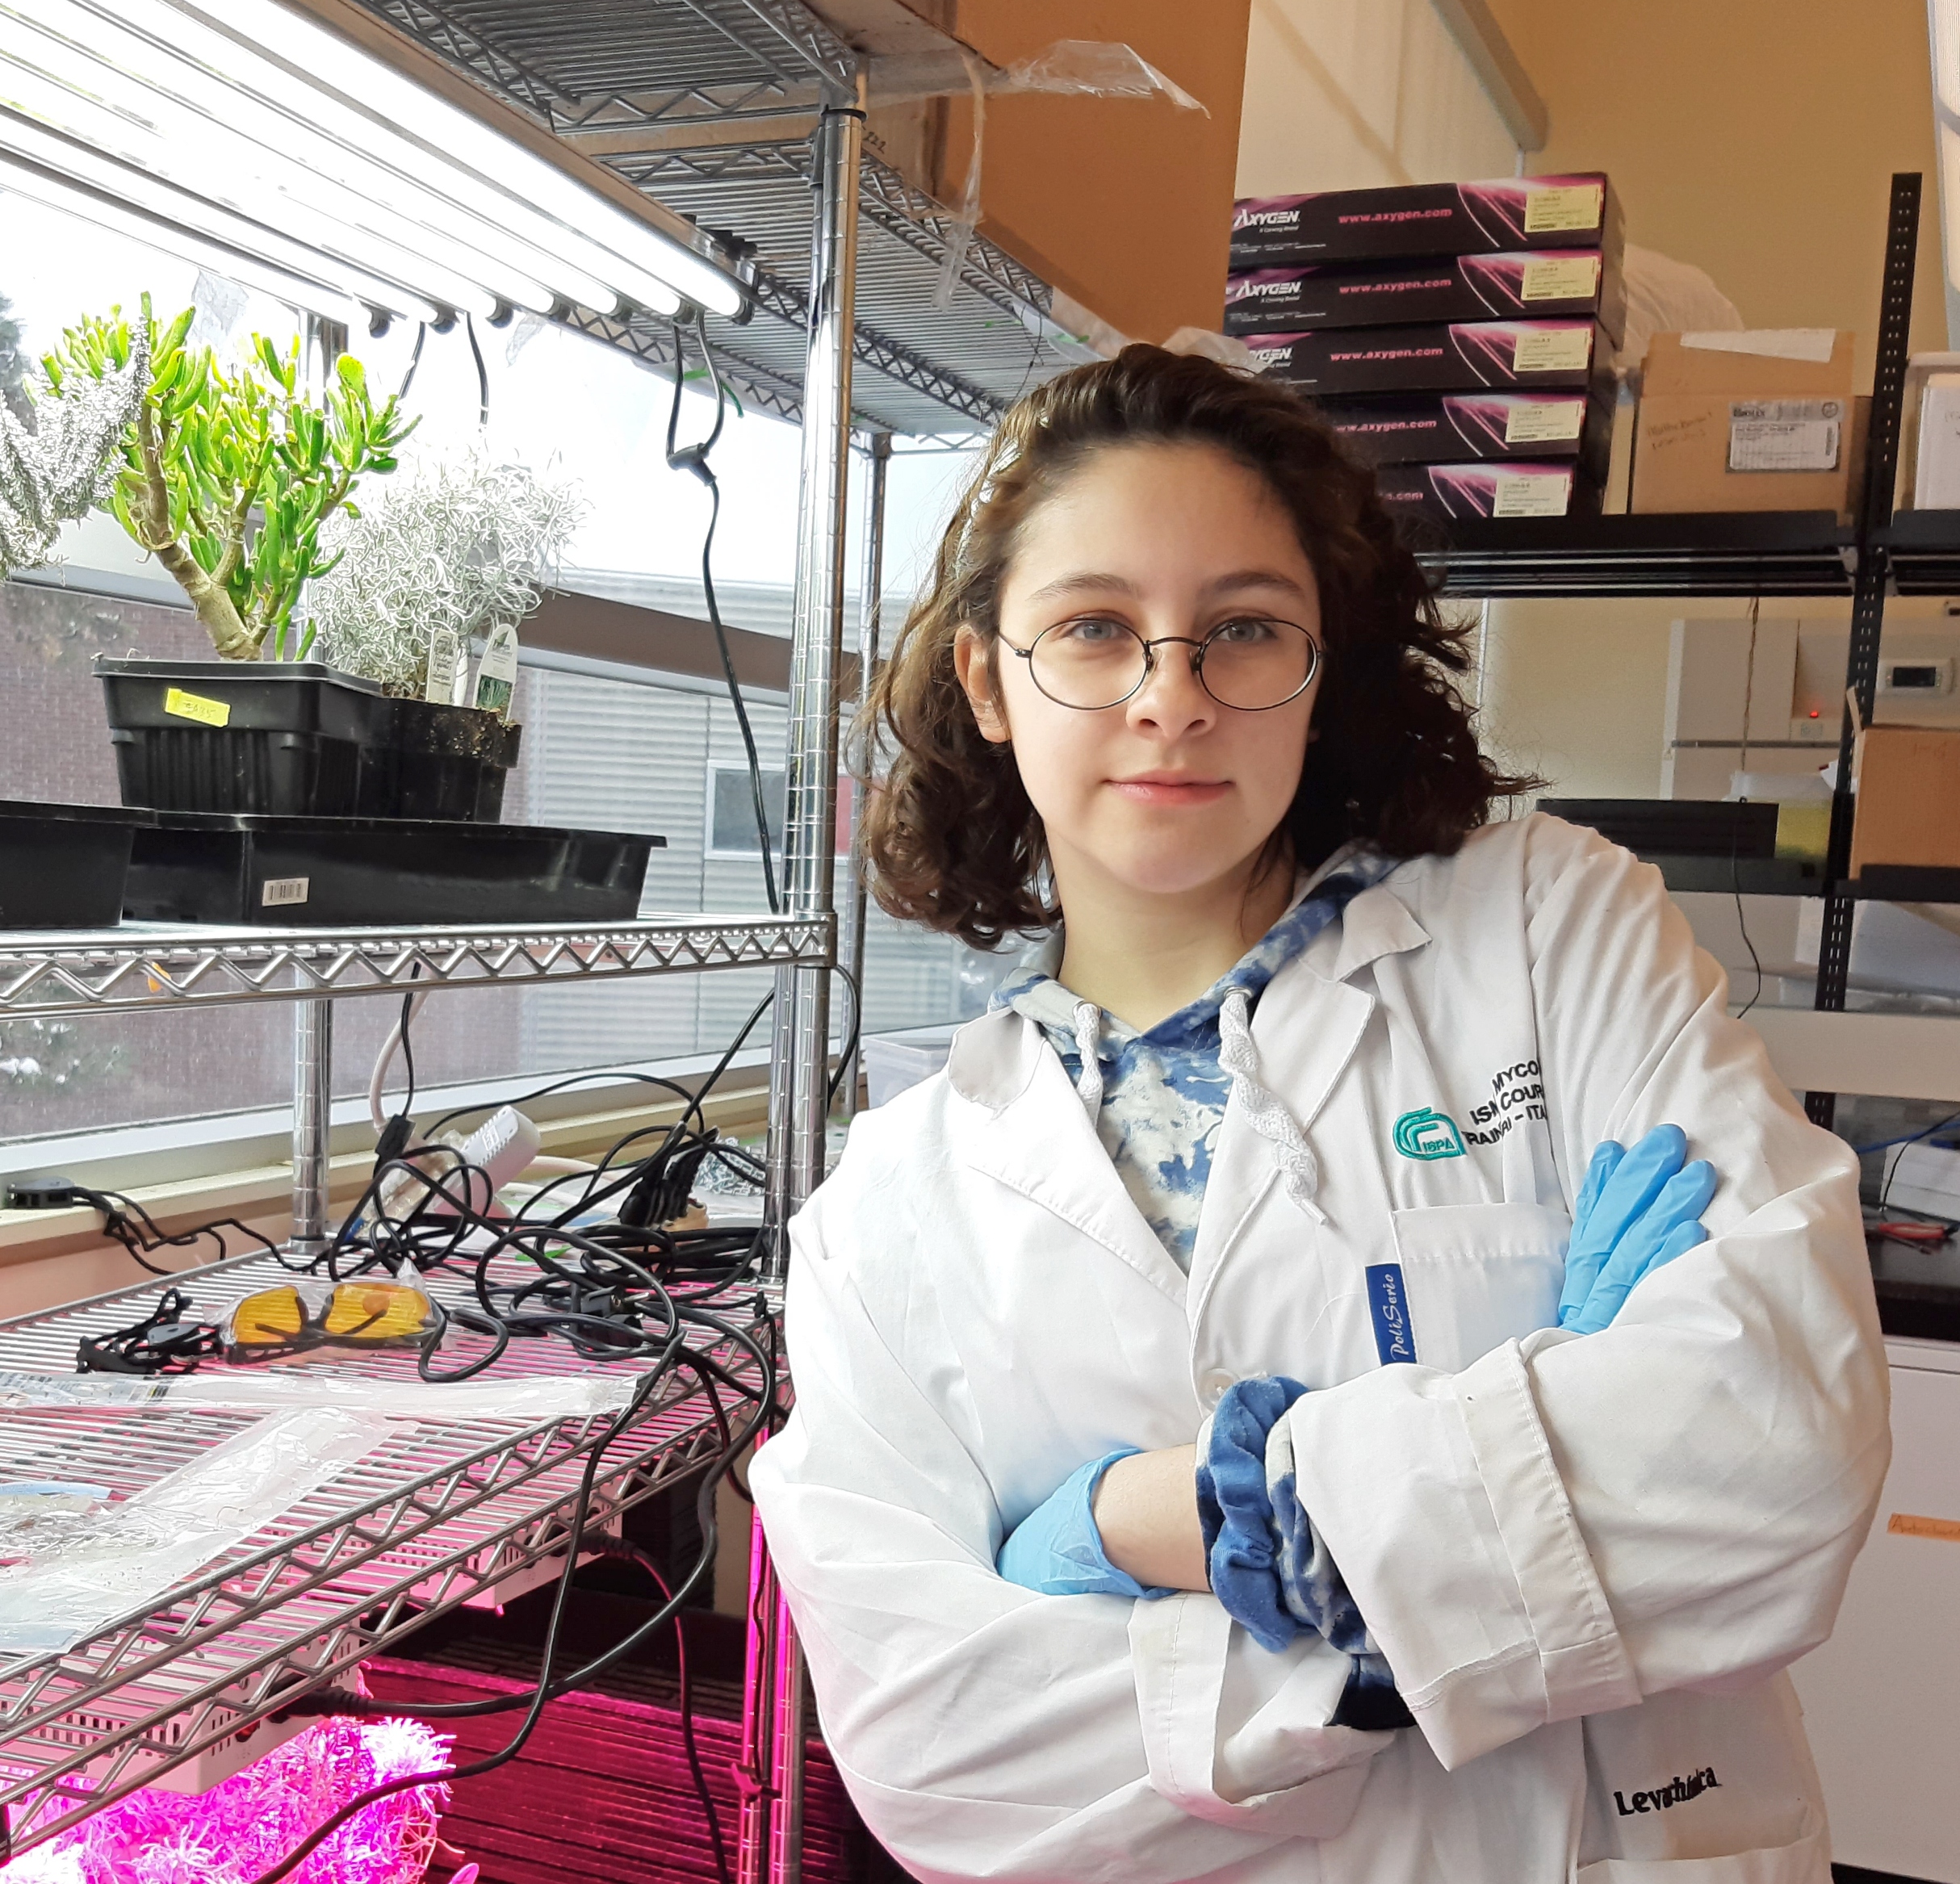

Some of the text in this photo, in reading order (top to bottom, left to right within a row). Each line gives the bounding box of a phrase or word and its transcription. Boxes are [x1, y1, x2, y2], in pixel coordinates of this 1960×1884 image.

[1233, 209, 1300, 227] AXYGEN
[1338, 209, 1452, 224] www.axygen.com
[1236, 280, 1301, 298] AXYGEN
[1339, 279, 1451, 294] www.axygen.com
[1330, 348, 1443, 361] www.axygen.com
[1492, 1060, 1539, 1096] MYCO
[1382, 1274, 1409, 1361] PoliSerio
